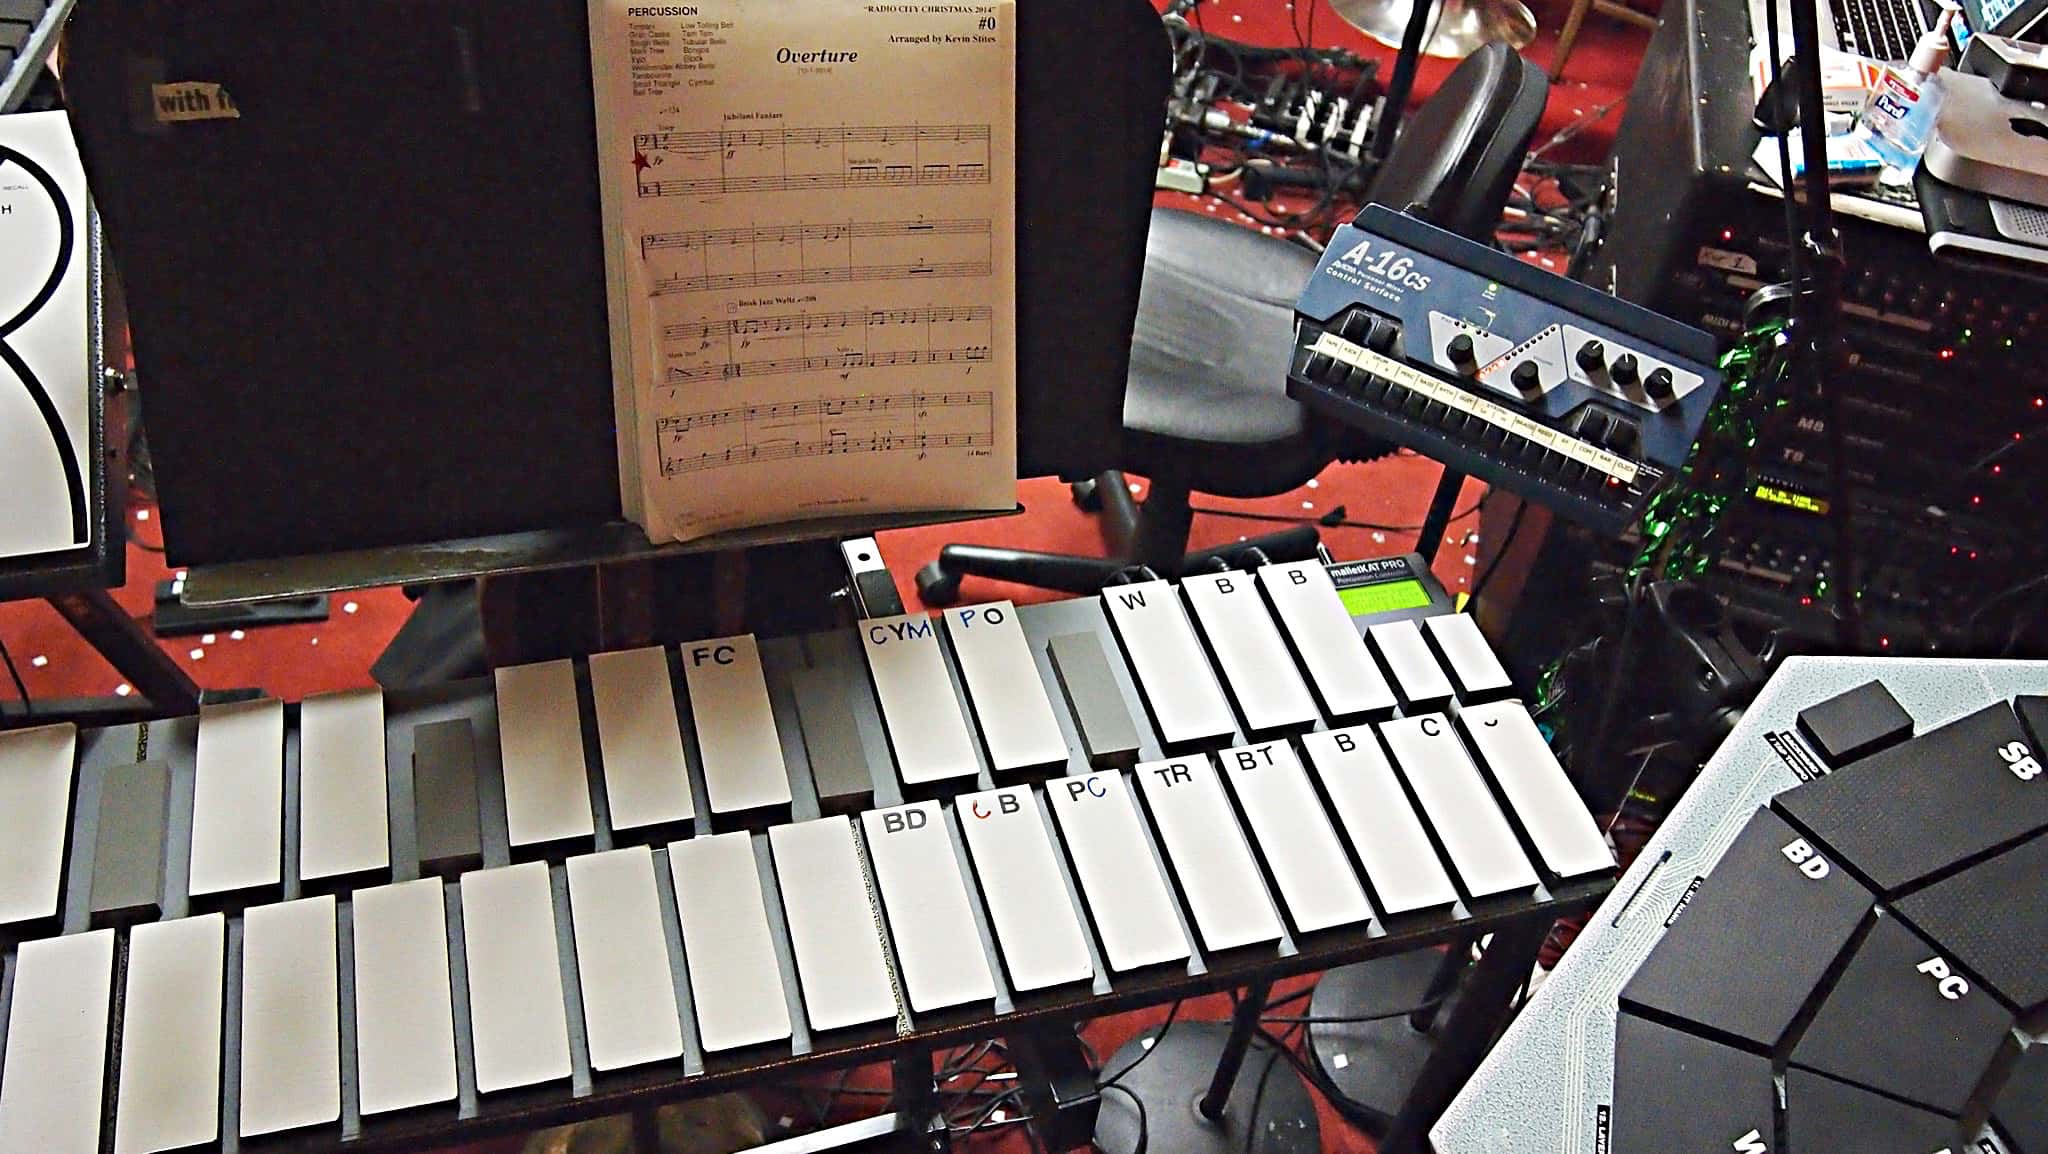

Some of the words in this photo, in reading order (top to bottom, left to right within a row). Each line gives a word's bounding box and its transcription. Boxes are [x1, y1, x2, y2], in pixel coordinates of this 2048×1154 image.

[628, 7, 698, 17] PERCUSSION
[978, 16, 996, 30] #0
[888, 35, 930, 45] Arranged
[932, 34, 942, 44] by
[945, 34, 970, 43] Kevin
[776, 47, 858, 63] Overture
[158, 88, 210, 113] with
[1326, 266, 1361, 287] Control
[1363, 280, 1401, 303] Surface
[1289, 569, 1308, 586] B
[1331, 561, 1381, 578] malletKAT
[1381, 559, 1406, 571] PRO
[1216, 578, 1235, 595] B
[1119, 592, 1147, 611] W
[868, 620, 934, 645] CYM
[693, 645, 736, 668] FC
[1421, 718, 1441, 738] C
[1335, 733, 1356, 753] B
[1236, 745, 1275, 772] BT
[1785, 755, 1809, 781] TEMPO
[1998, 741, 2043, 780] SB
[1154, 763, 1193, 790] TR
[1066, 777, 1107, 803] PC
[881, 807, 927, 834] BD
[1781, 837, 1831, 880] BD
[1916, 956, 1970, 1000] PC
